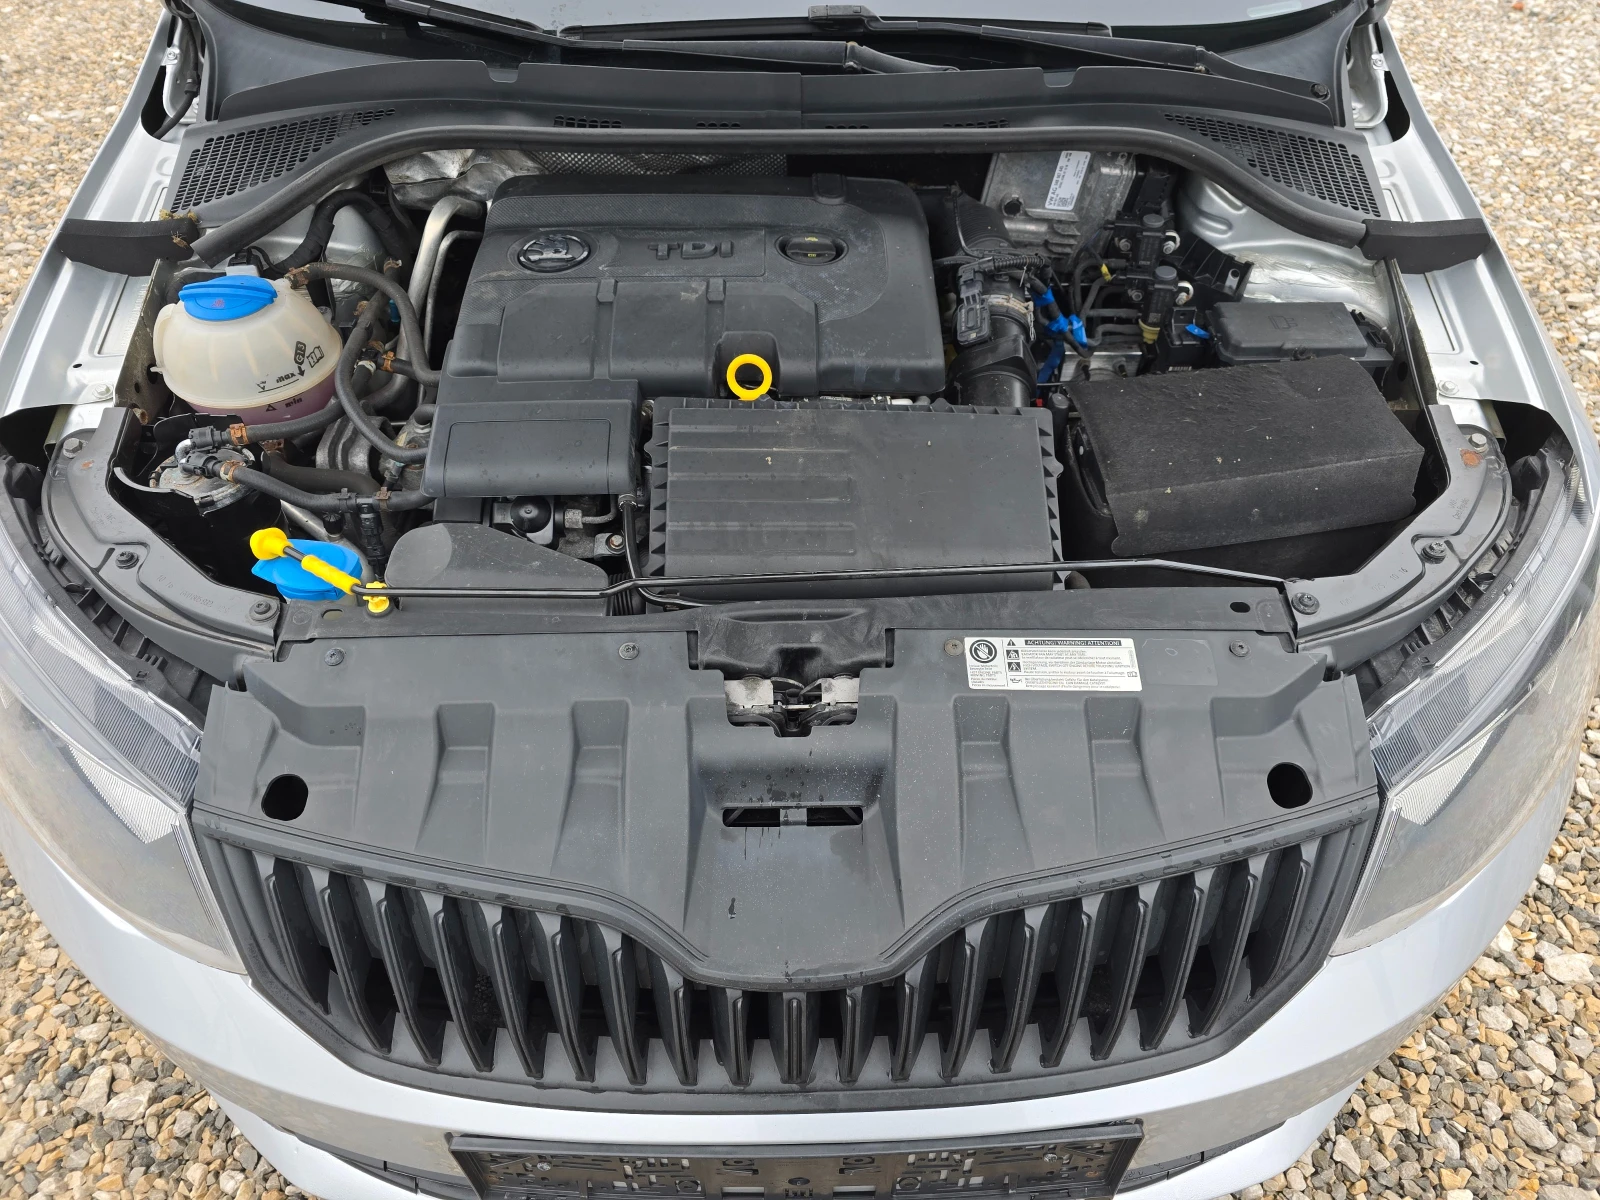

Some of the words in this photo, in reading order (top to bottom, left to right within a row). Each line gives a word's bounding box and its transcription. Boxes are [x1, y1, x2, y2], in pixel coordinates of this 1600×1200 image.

[1047, 196, 1054, 206] VW
[1051, 187, 1058, 195] AG
[648, 240, 735, 260] TDI
[295, 342, 306, 364] G13
[276, 372, 296, 384] max
[285, 397, 303, 408] min
